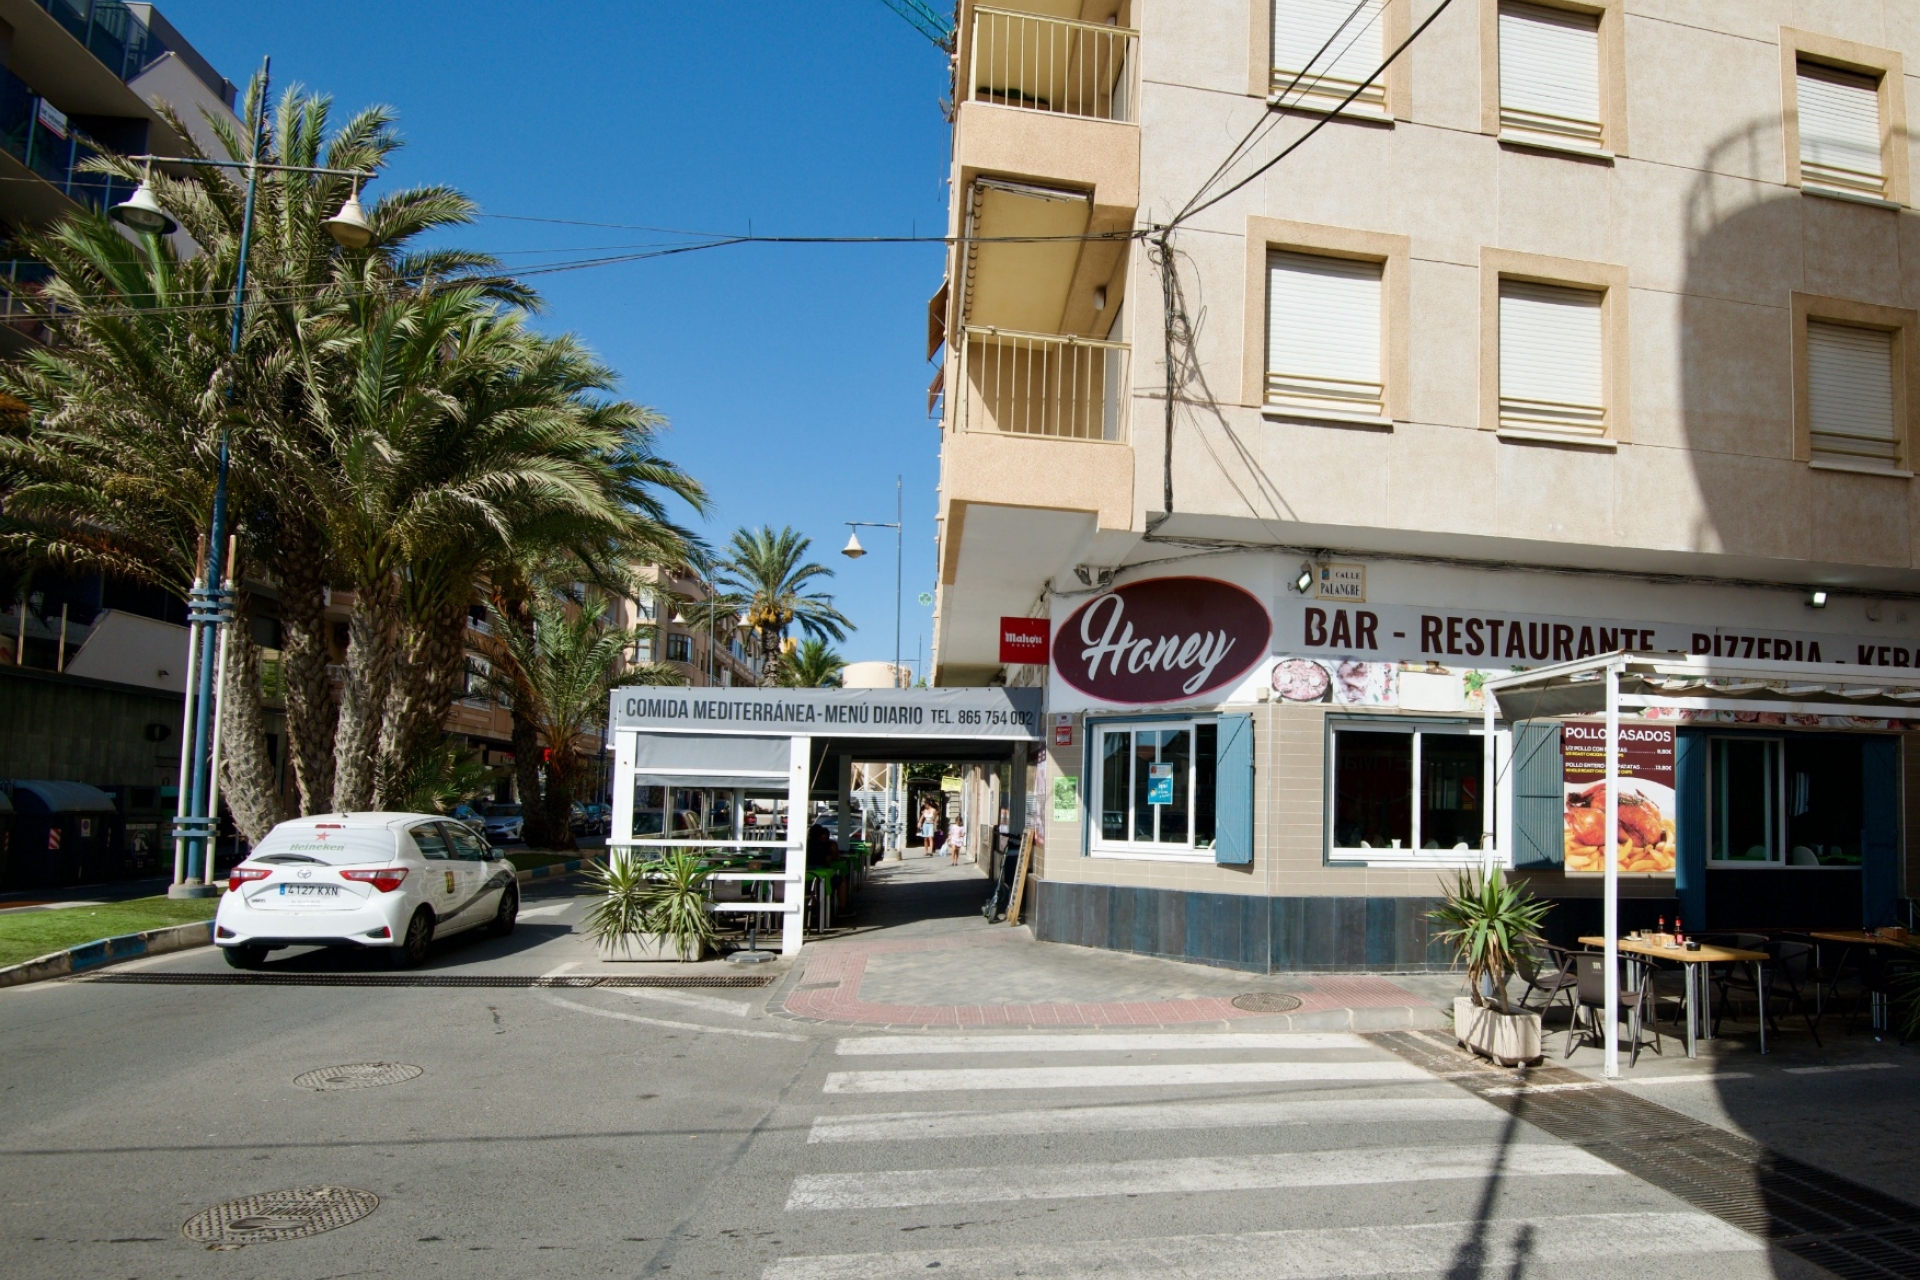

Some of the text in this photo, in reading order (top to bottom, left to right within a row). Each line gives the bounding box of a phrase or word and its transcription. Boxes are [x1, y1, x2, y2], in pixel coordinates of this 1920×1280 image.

[1320, 582, 1360, 596] PALANGRE
[1005, 631, 1042, 644] Mahou
[1080, 593, 1236, 694] Honey
[1304, 607, 1378, 650] BAR
[1421, 615, 1655, 662] RESTAURANTE
[1858, 644, 1920, 668] KEB
[626, 698, 688, 718] COMIDA
[874, 706, 923, 724] DIARIO
[931, 709, 954, 724] TEL.
[958, 710, 981, 725] 865
[985, 710, 1007, 725] 754
[1011, 711, 1033, 725] 002
[1566, 728, 1671, 742] POLLO ASADOS
[288, 885, 338, 896] 4127 KXN
